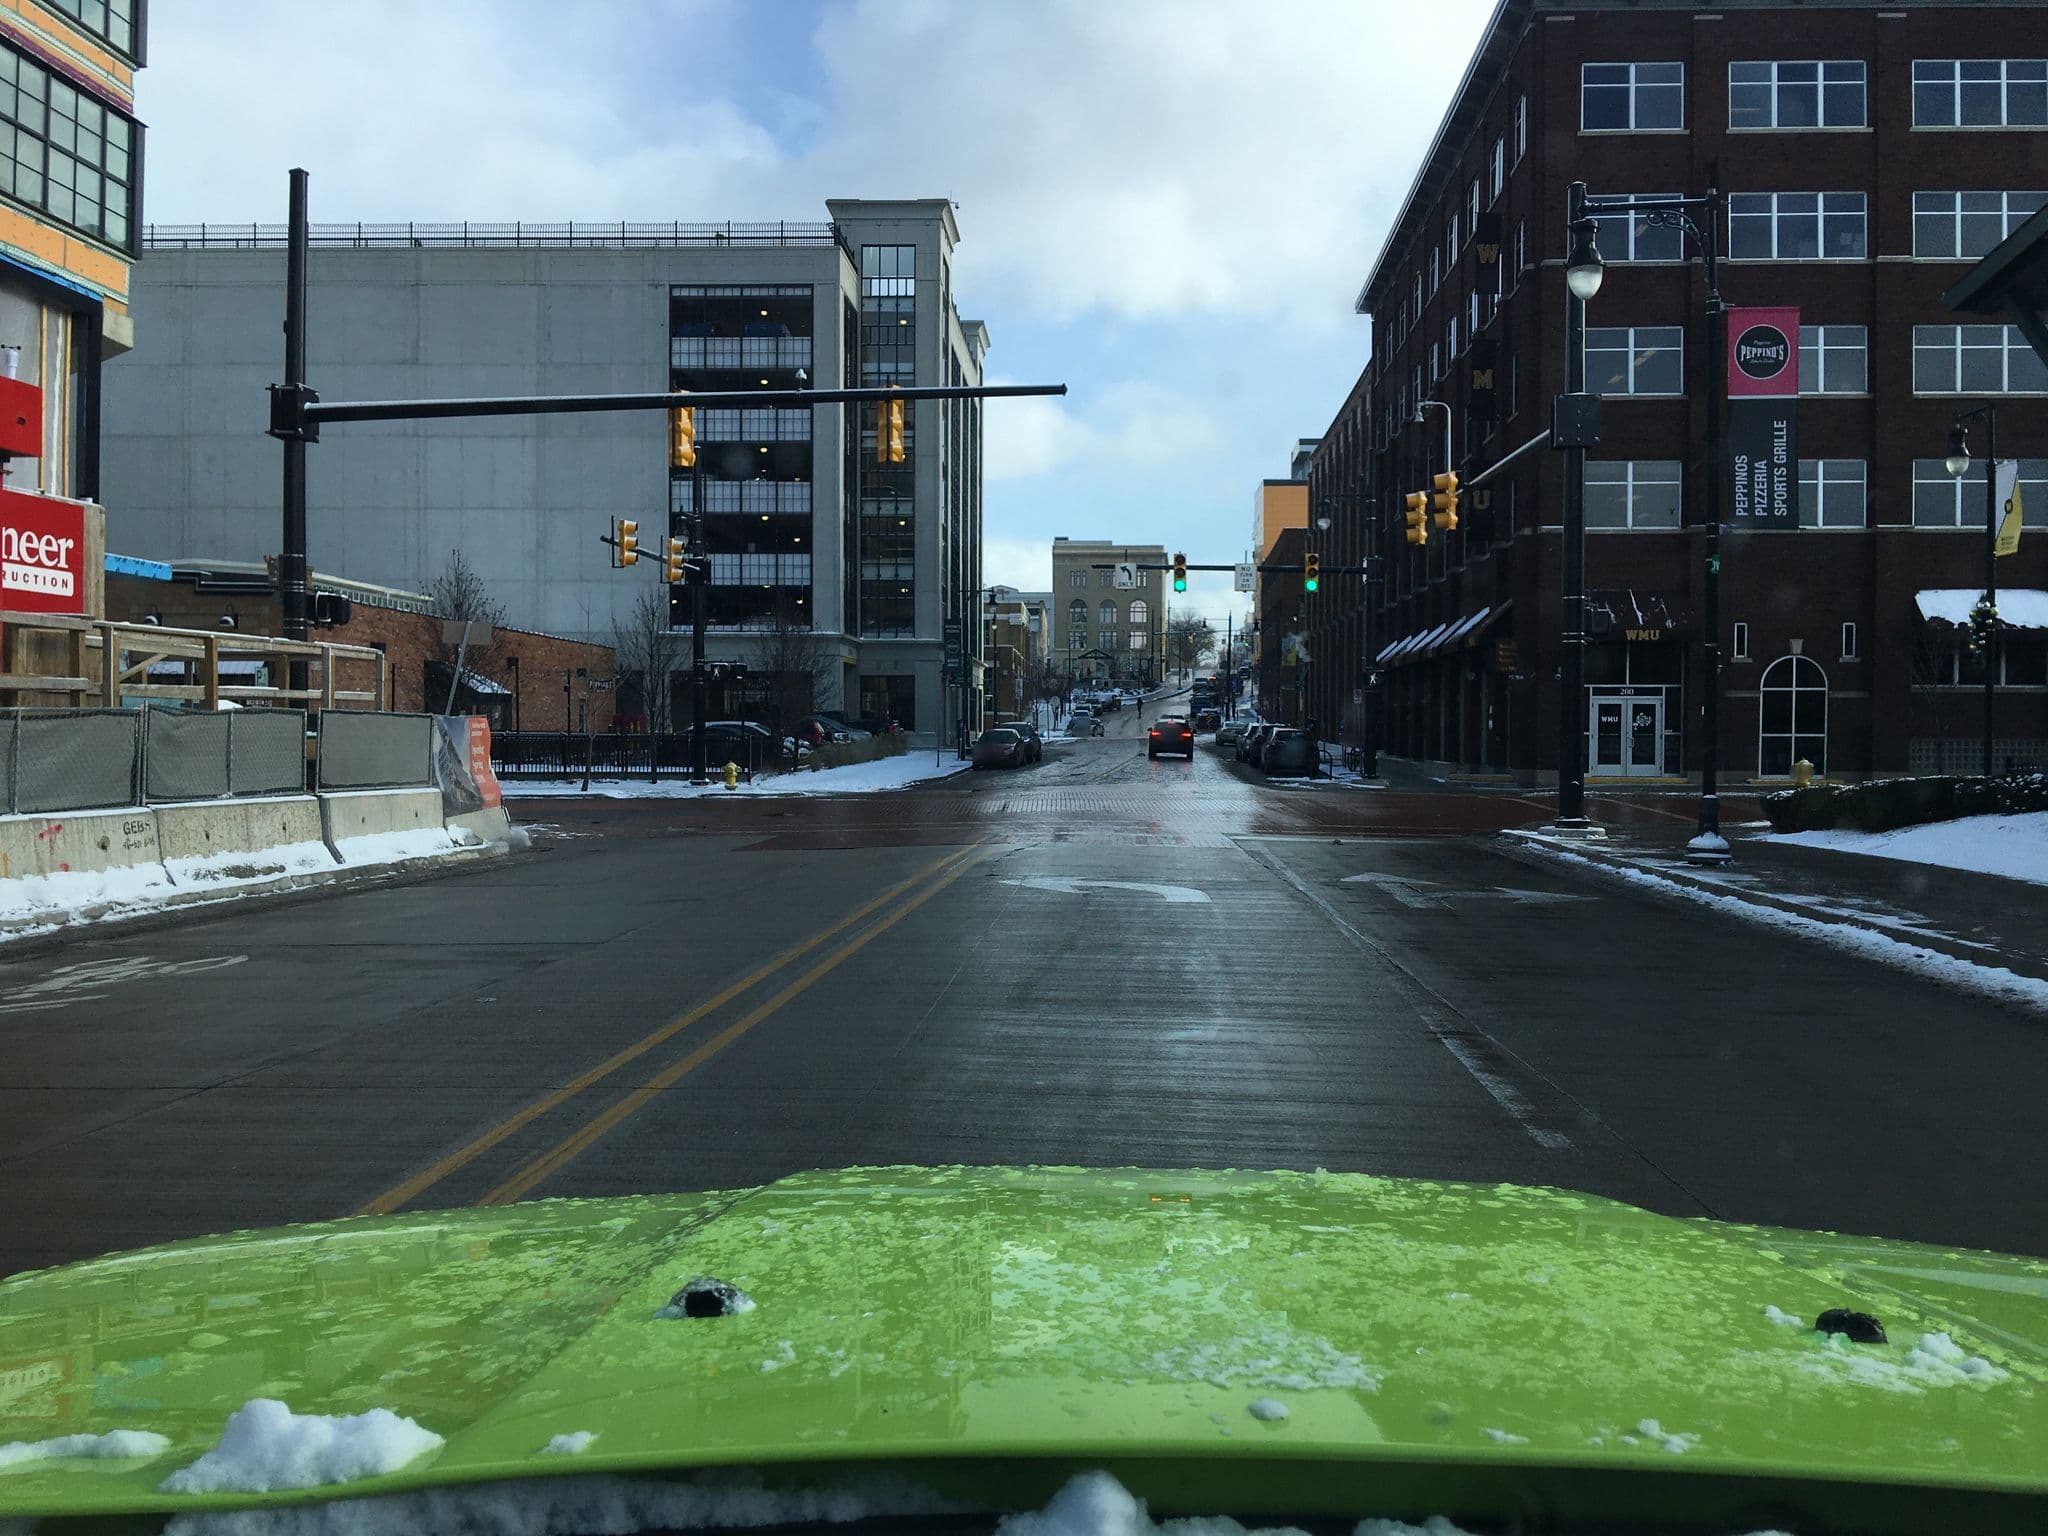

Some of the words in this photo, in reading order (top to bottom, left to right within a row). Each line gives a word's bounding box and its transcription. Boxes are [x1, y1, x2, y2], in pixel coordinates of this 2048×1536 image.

[1740, 344, 1784, 362] PEPPINO'S
[1774, 420, 1787, 464] GRILLE
[1735, 455, 1749, 516] PEPPINOS
[1754, 460, 1768, 516] PIZZERIA
[1774, 467, 1788, 517] SPORTS
[2, 526, 75, 569] neer
[1625, 630, 1660, 640] WMU
[1601, 715, 1619, 723] WMU
